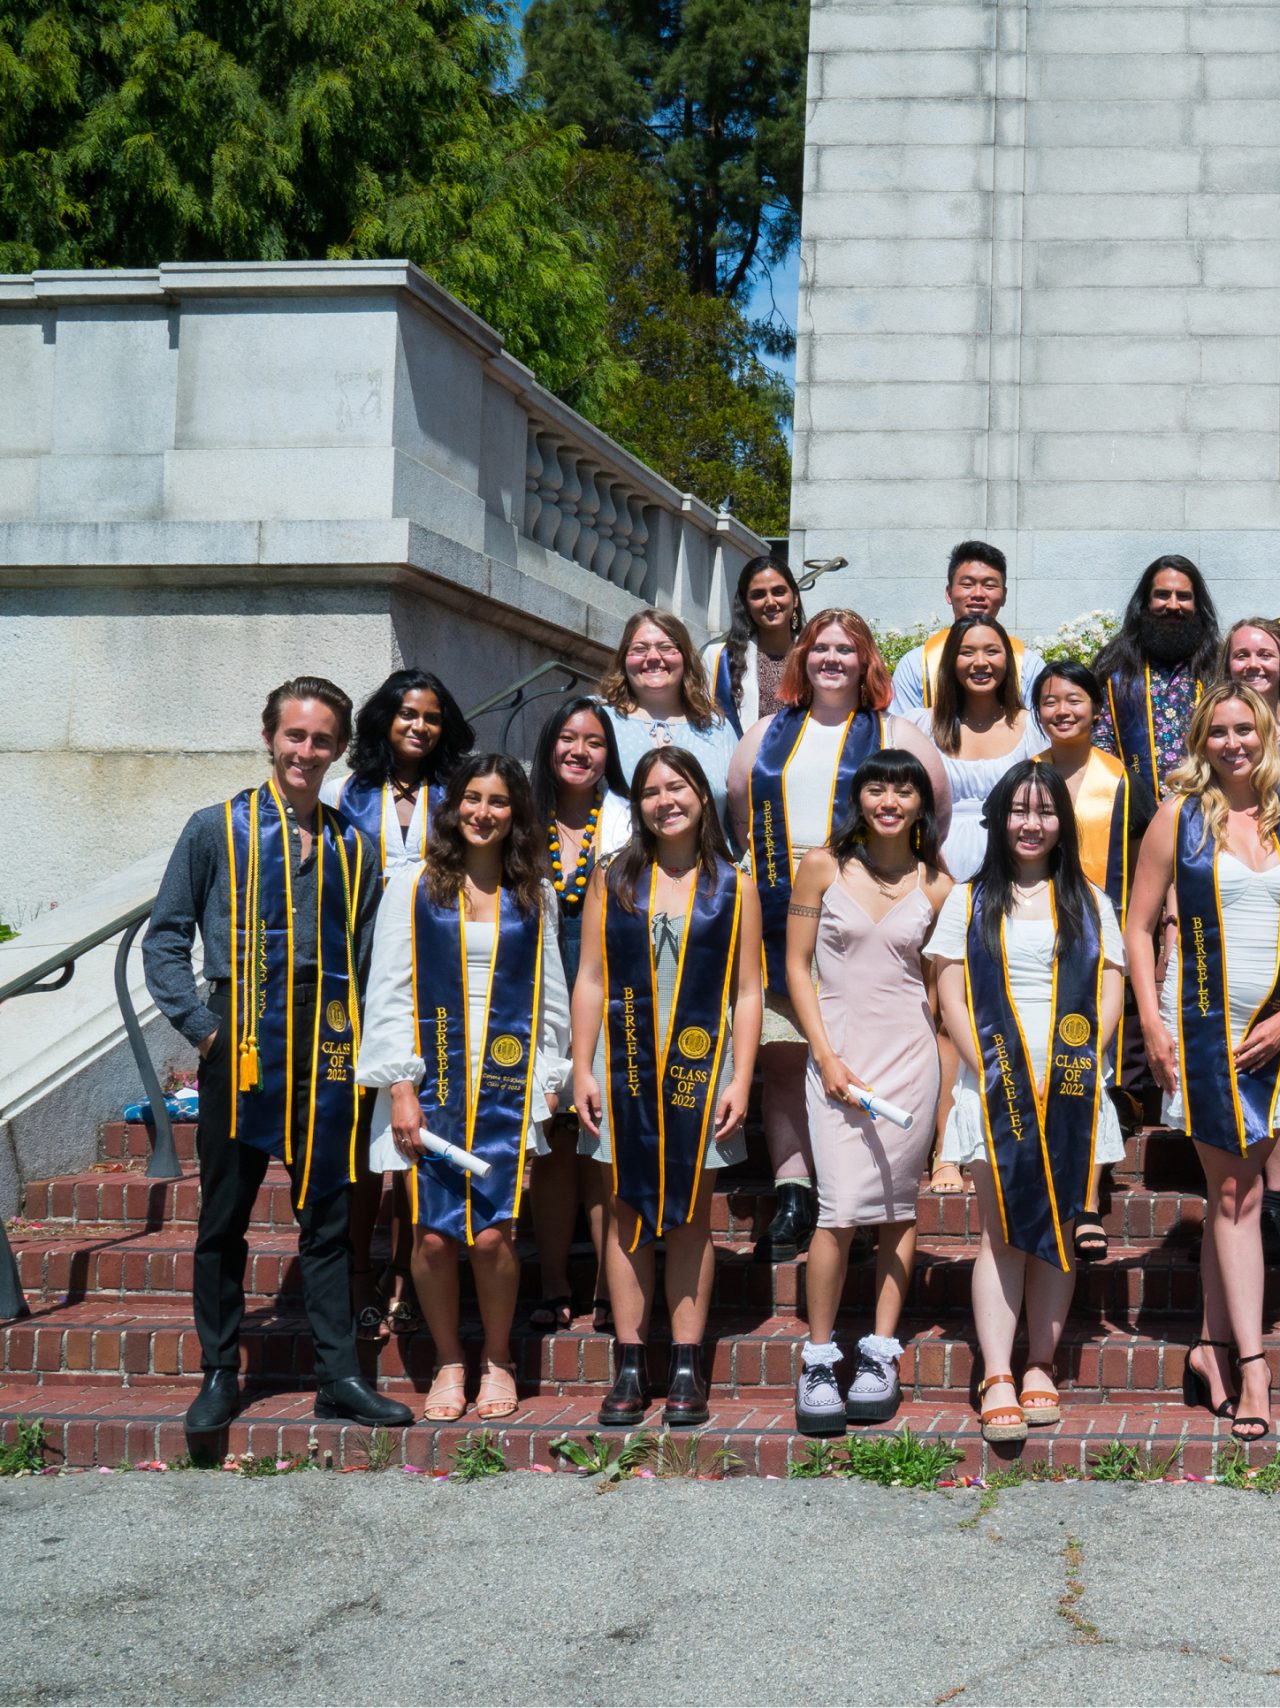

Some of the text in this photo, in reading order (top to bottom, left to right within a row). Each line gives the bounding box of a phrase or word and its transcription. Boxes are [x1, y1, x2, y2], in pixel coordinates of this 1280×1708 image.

[763, 800, 777, 888] BERKELEY
[1192, 916, 1210, 1017] BERKELEY
[321, 1041, 351, 1055] CLASS
[623, 986, 639, 1097] BERKELEY
[330, 1055, 345, 1068] OF
[435, 1006, 449, 1106] BERKELEY
[1055, 1054, 1092, 1070] CLASS
[325, 1068, 347, 1081] 2022
[670, 1065, 708, 1083] CLASS
[1064, 1068, 1082, 1083] OF
[677, 1081, 696, 1095] OF
[992, 1033, 1025, 1142] BERKELEY
[1059, 1082, 1085, 1097] 2022
[670, 1093, 696, 1109] 2022
